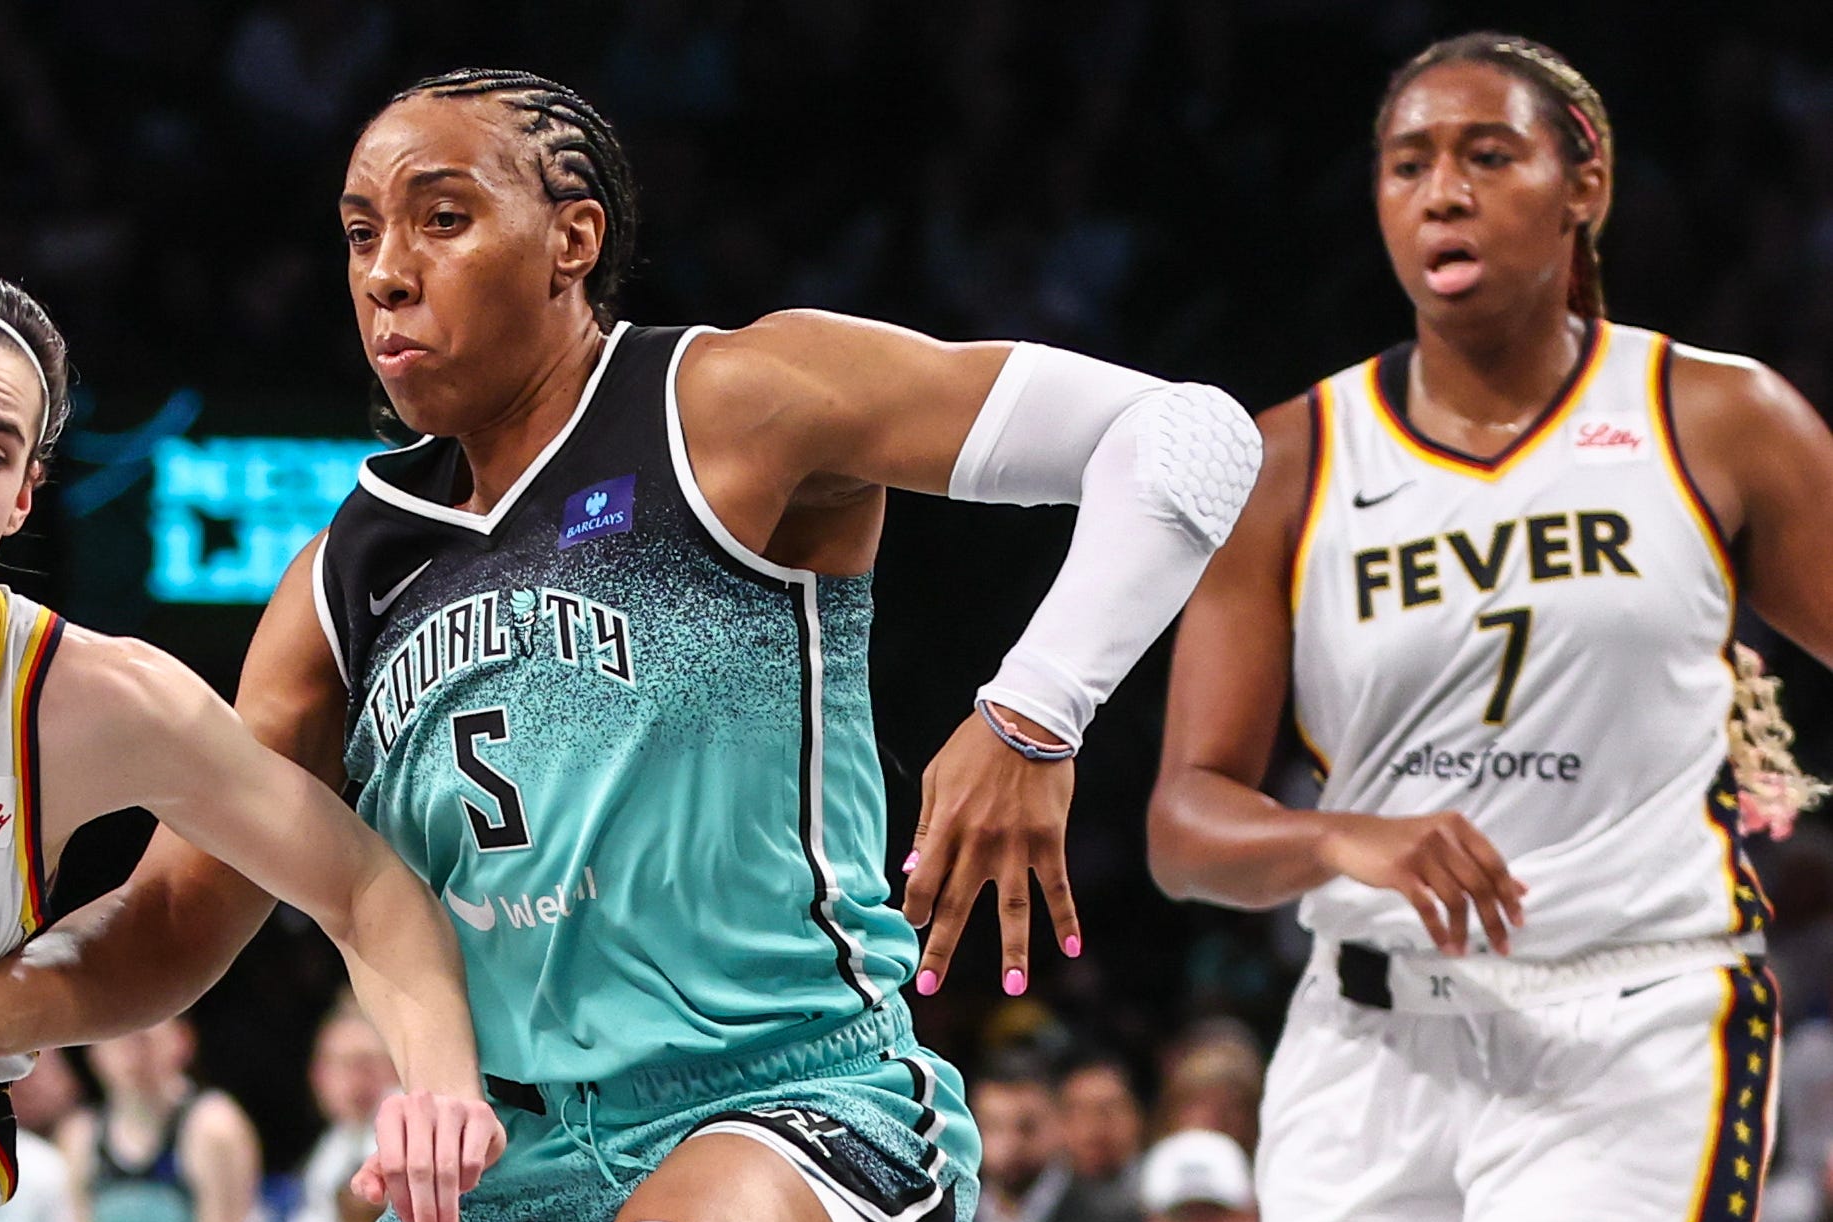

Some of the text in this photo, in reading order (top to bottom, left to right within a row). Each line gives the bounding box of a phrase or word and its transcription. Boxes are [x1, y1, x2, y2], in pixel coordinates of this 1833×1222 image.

[566, 511, 625, 539] BARCLAYS
[1353, 510, 1642, 622] FEVER
[1477, 606, 1534, 725] 7
[450, 705, 533, 854] 5
[1391, 739, 1581, 790] salesforce
